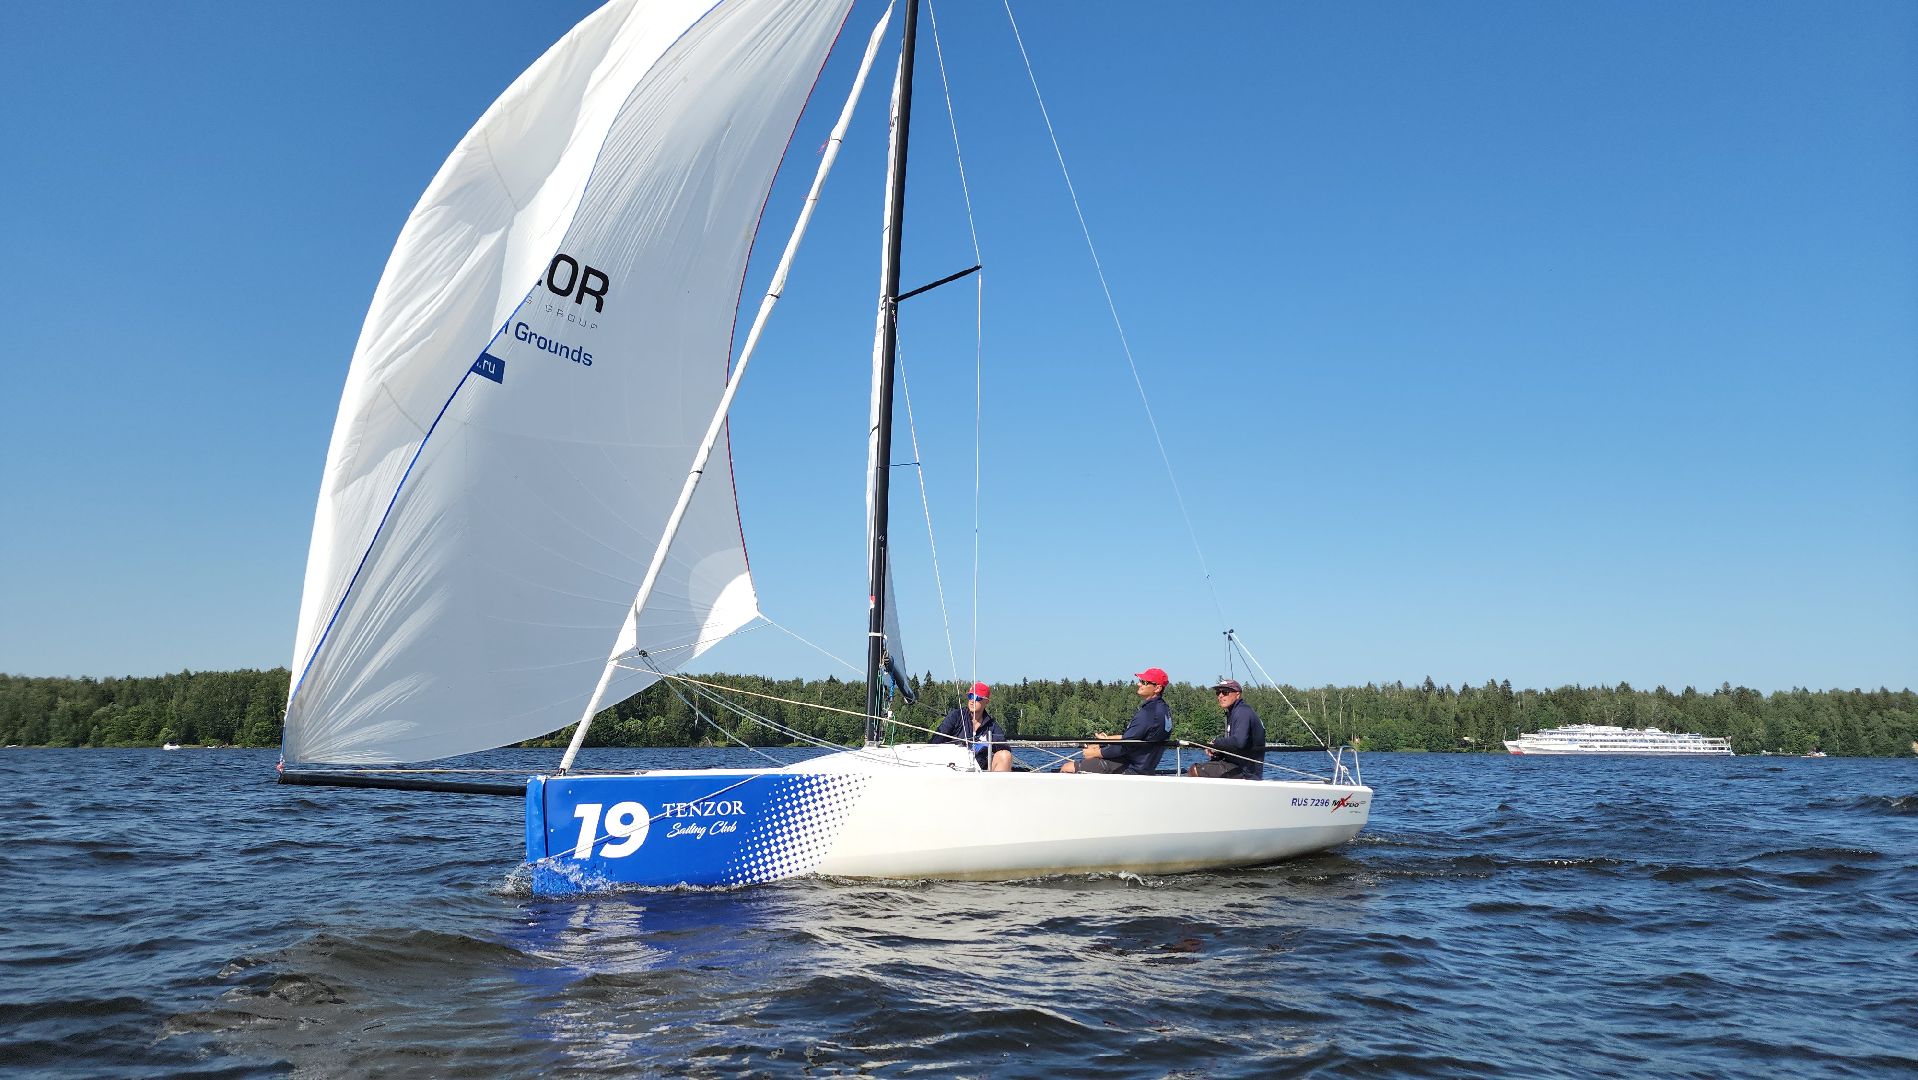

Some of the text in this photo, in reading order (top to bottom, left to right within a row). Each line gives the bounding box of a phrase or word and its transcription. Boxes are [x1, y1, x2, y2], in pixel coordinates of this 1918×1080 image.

[536, 253, 610, 314] OR
[514, 321, 593, 367] Grounds
[662, 800, 746, 819] TENZOR
[1291, 798, 1308, 807] RUS
[1310, 798, 1330, 807] 7296
[573, 801, 650, 859] 19
[666, 820, 737, 839] Sailing Club
